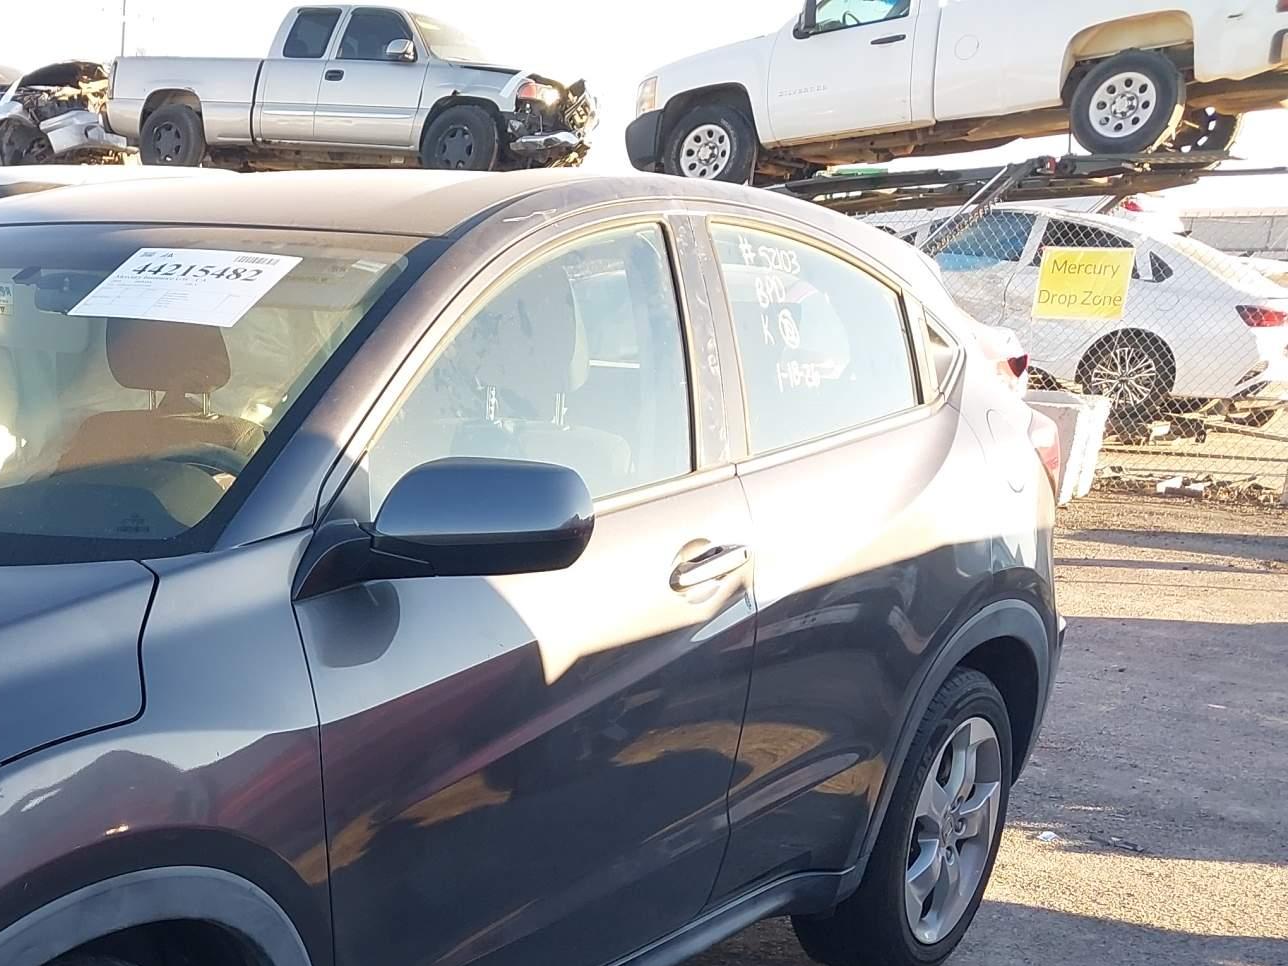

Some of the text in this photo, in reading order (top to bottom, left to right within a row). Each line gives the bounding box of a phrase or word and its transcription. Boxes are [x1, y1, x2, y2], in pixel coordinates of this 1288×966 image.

[132, 262, 263, 282] 44215482
[1051, 259, 1120, 279] Mercury
[1038, 290, 1122, 308] Drop Zone
